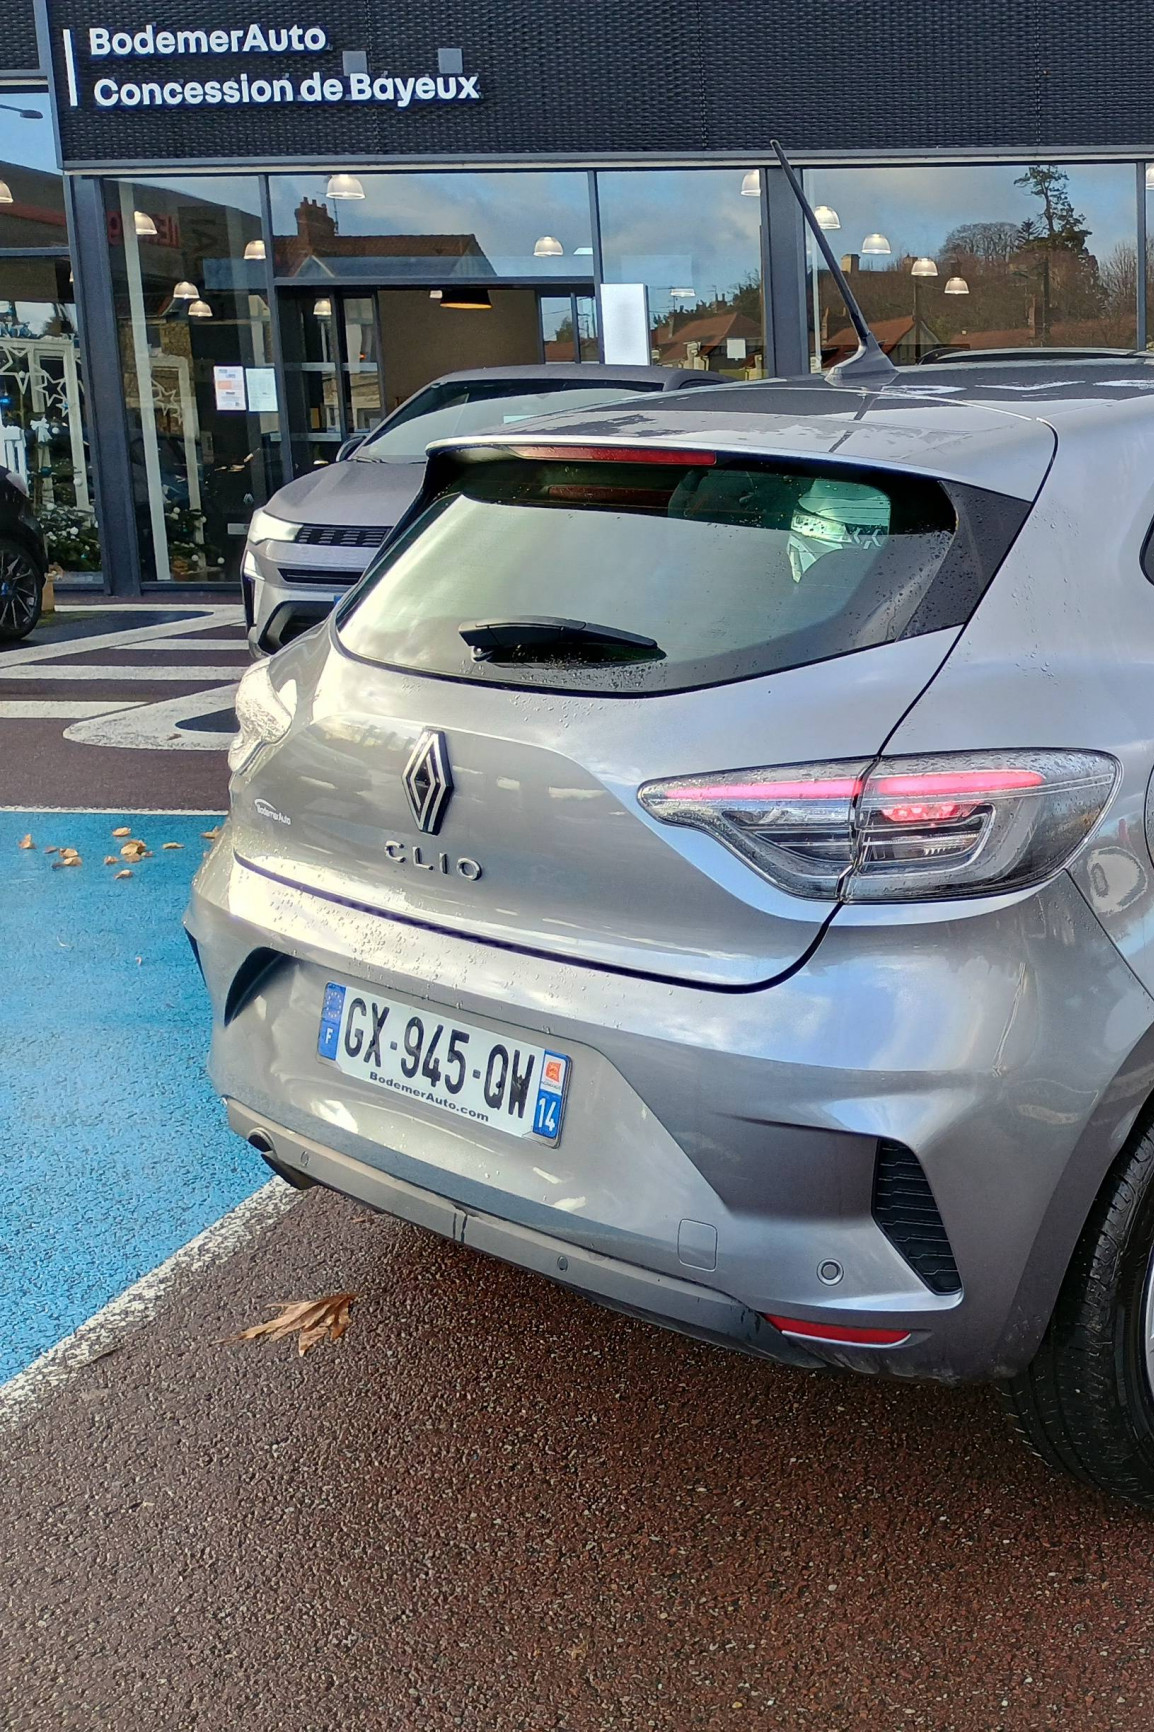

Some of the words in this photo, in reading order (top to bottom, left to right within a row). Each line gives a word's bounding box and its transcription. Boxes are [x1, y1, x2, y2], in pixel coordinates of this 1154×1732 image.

[89, 24, 327, 55] BodemerAuto
[93, 73, 294, 106] Concession
[300, 71, 343, 102] de
[350, 73, 480, 107] Bayeux
[384, 840, 482, 880] CLIO
[323, 1027, 333, 1044] F
[369, 1071, 489, 1122] BodemerAuto.com
[538, 1097, 556, 1132] 14
